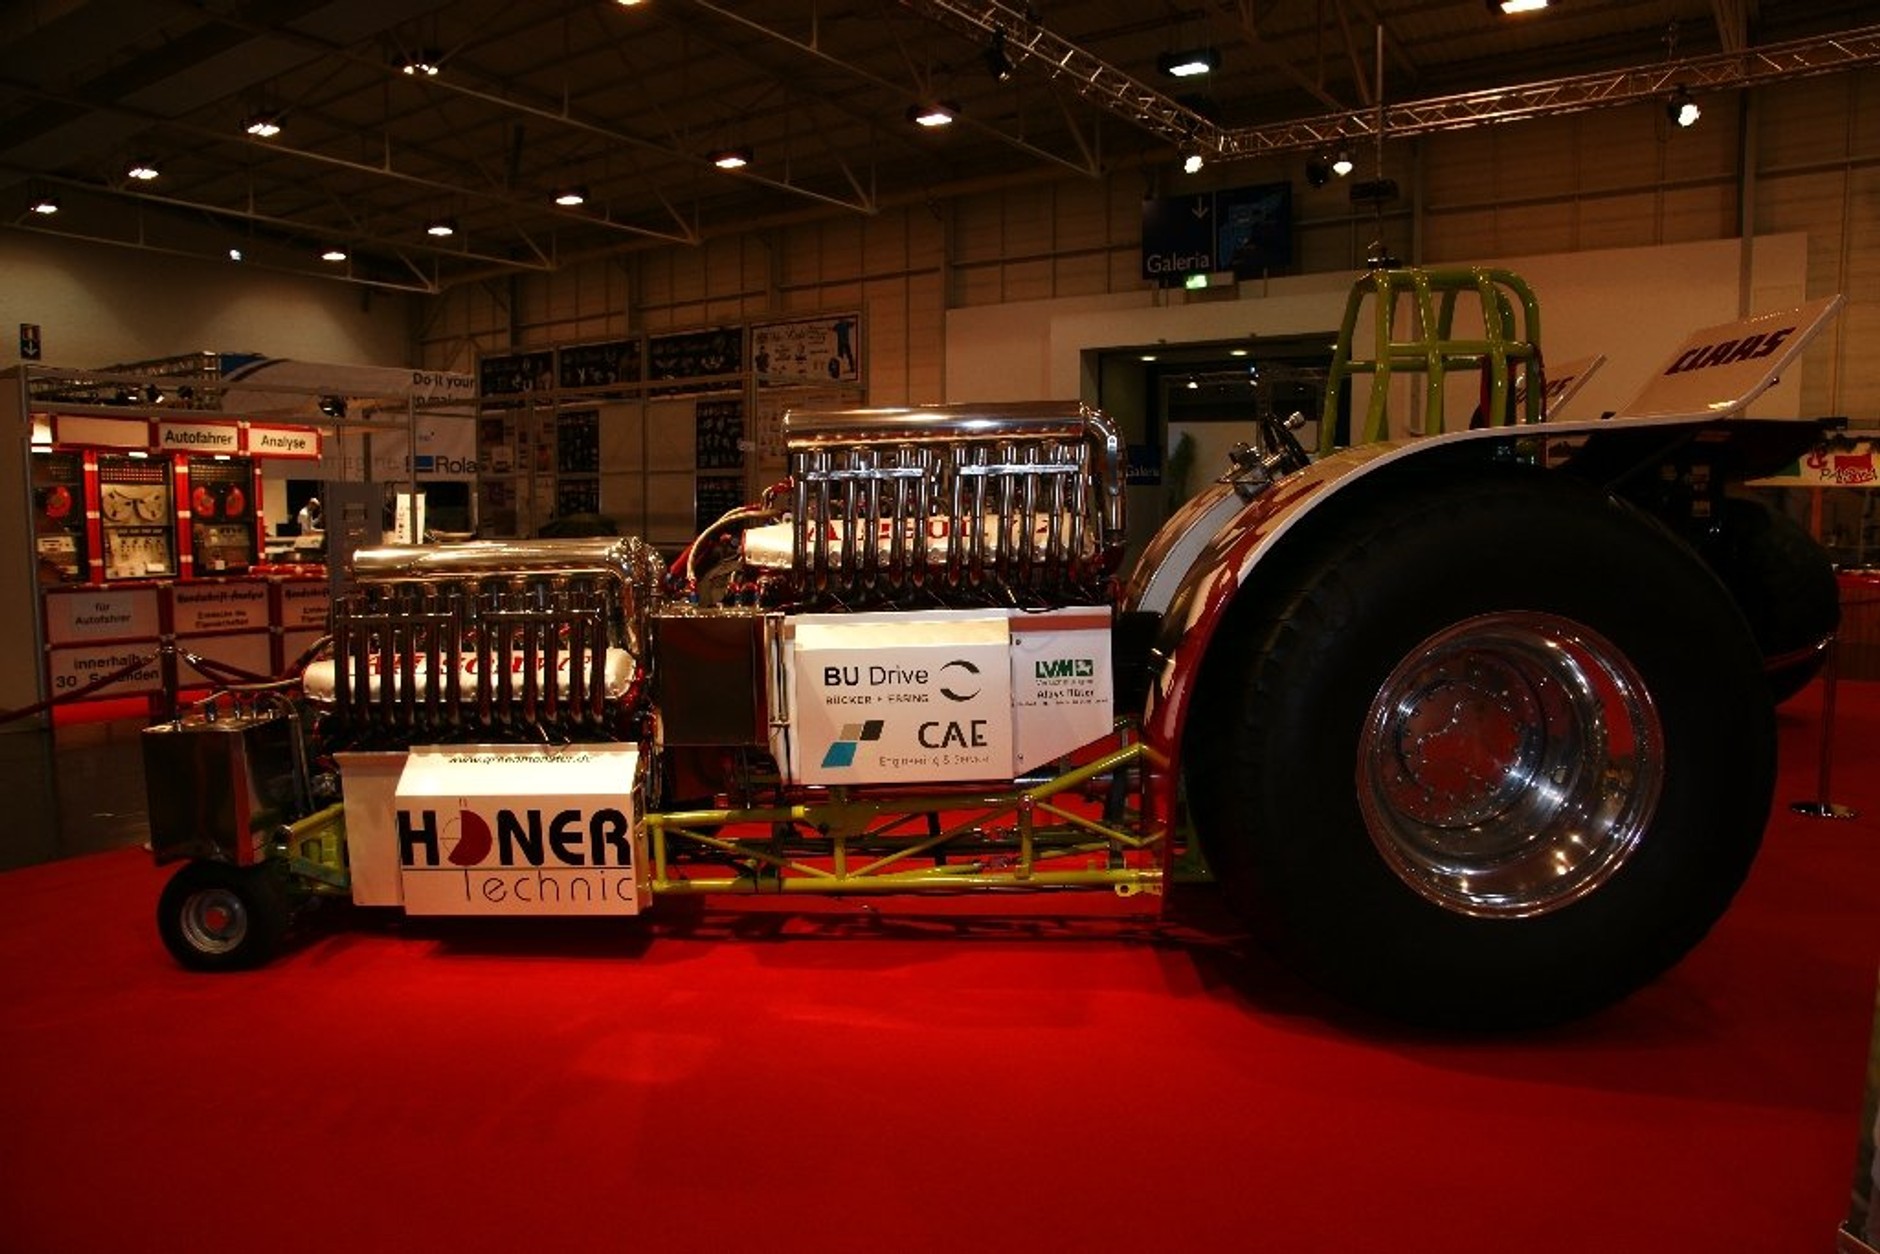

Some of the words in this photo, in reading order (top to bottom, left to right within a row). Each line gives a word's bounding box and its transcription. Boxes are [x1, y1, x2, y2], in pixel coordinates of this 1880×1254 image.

[1147, 252, 1211, 273] Galeria
[1664, 327, 1796, 376] CLAAS
[413, 372, 431, 385] Do
[435, 374, 443, 387] it
[447, 376, 475, 391] your
[165, 429, 233, 446] Autofahrer
[260, 434, 307, 450] Analyse
[75, 613, 131, 626] Autofahrer
[824, 666, 859, 686] BU
[870, 664, 929, 686] Drive
[1035, 659, 1073, 679] LVM
[56, 675, 77, 688] 30
[918, 720, 988, 749] CAE
[464, 867, 633, 903] Technic
